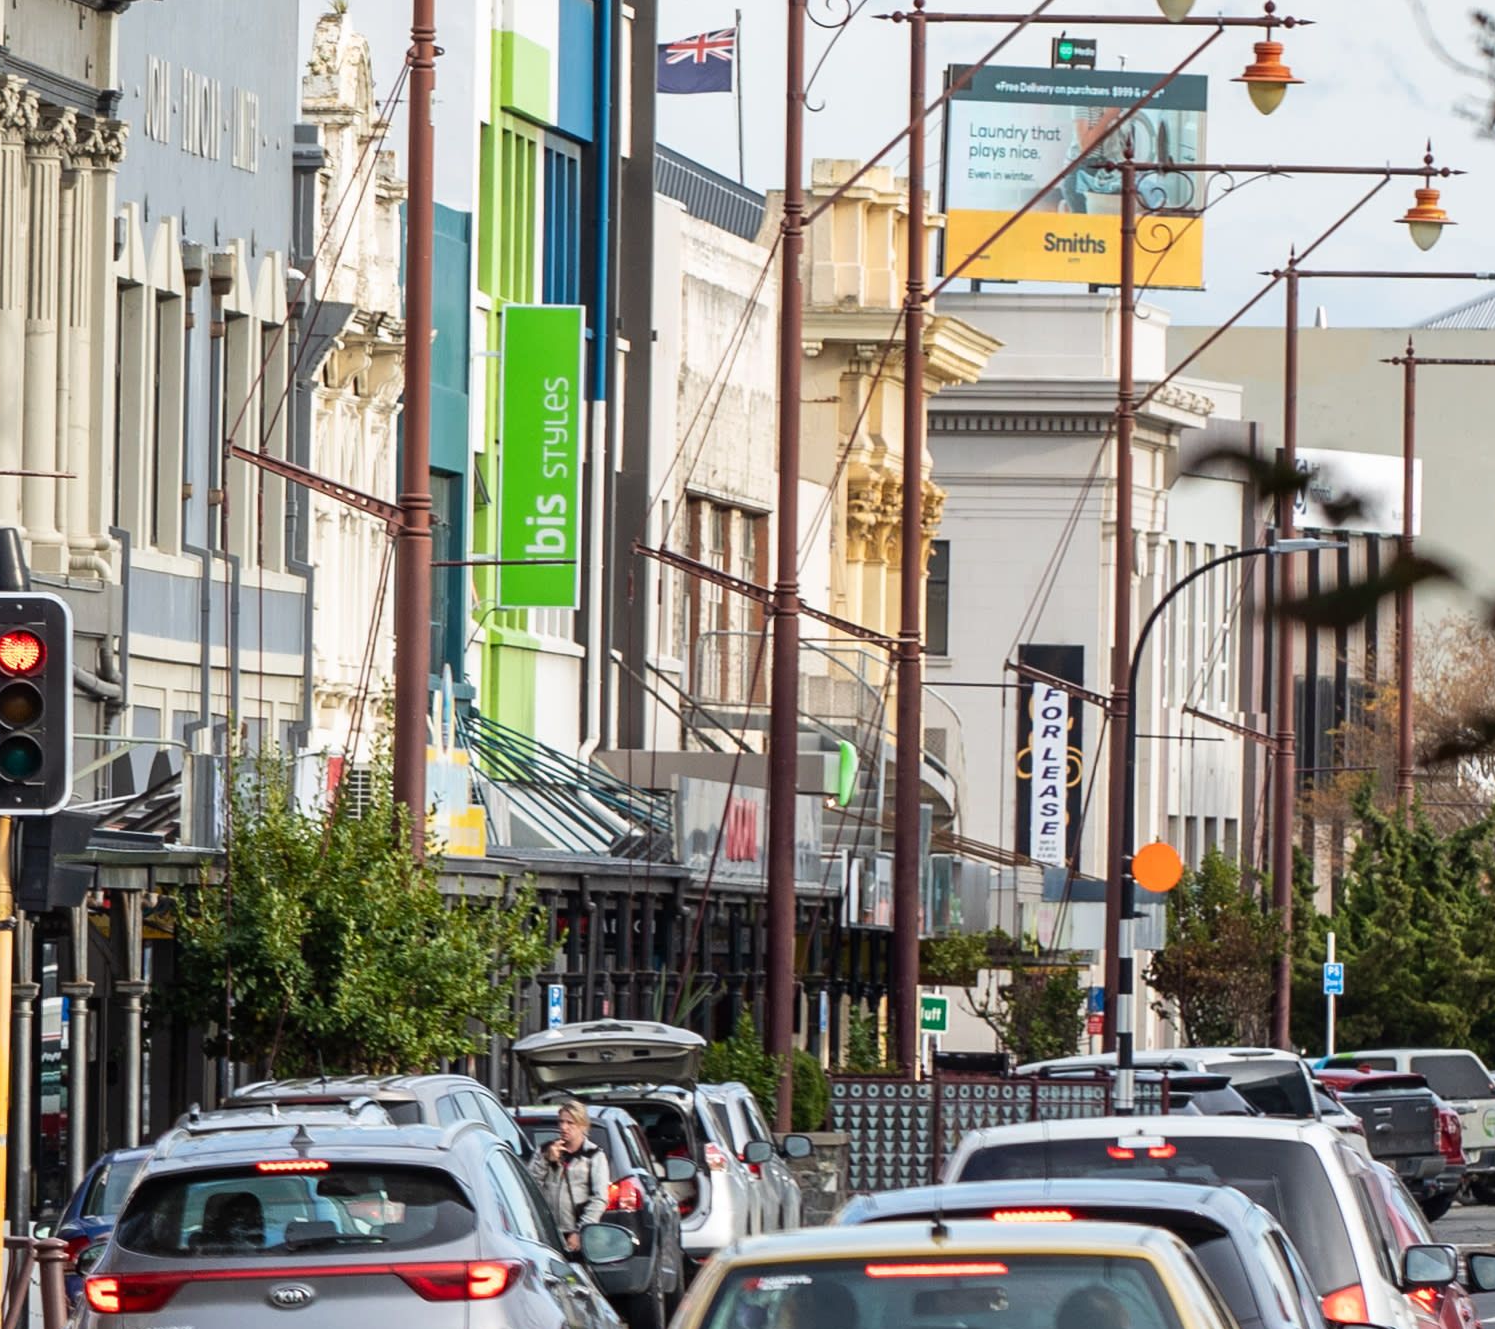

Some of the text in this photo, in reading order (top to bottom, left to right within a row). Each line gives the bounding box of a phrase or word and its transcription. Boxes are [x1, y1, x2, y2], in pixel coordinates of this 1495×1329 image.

[1020, 82, 1054, 95] Delivery
[1055, 85, 1067, 93] on
[970, 123, 1062, 142] Laundry that
[969, 144, 1041, 160] plays nice.
[968, 168, 1035, 182] Even in winter.
[1043, 233, 1106, 254] Smiths
[1041, 688, 1062, 739] FOR
[1039, 747, 1060, 836] LEASE
[921, 1006, 942, 1021] luff
[276, 1290, 306, 1302] KIA
